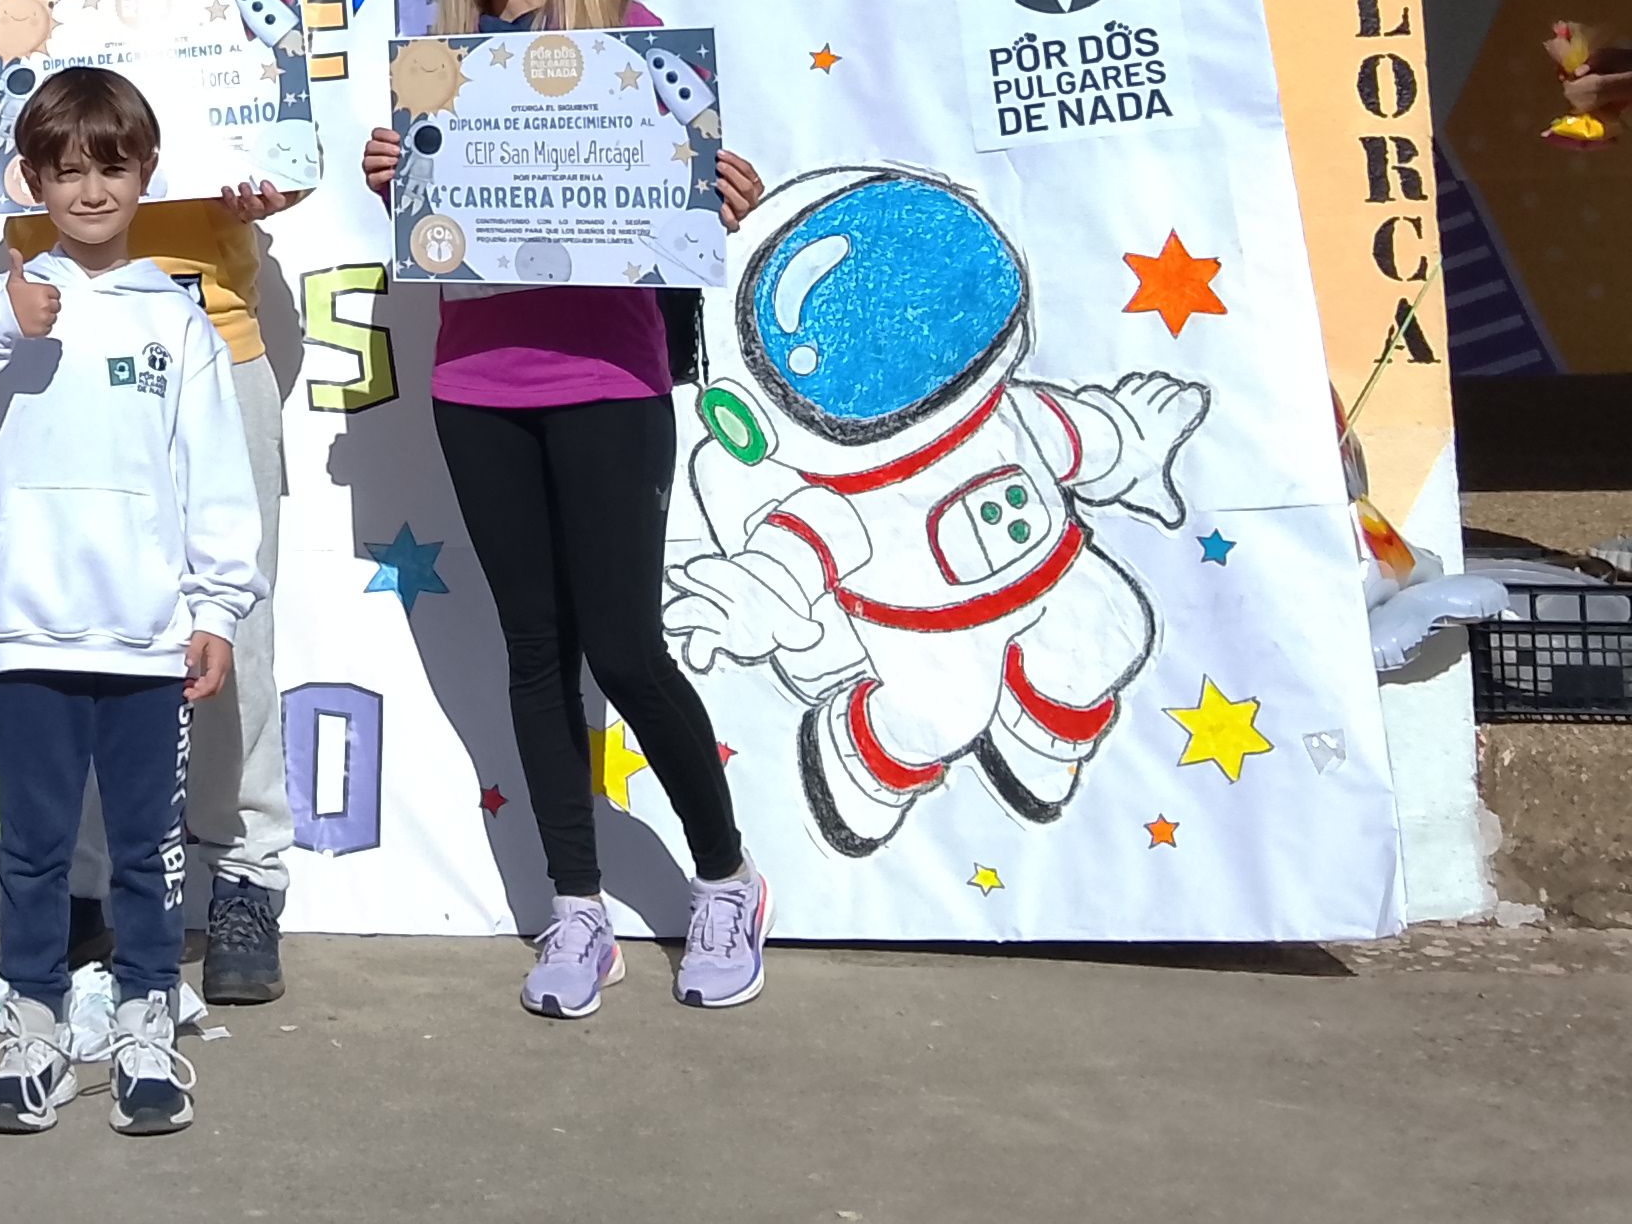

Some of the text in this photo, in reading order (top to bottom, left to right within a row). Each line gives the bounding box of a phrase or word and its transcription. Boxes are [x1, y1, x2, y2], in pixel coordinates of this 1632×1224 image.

[97, 54, 113, 65] DE
[229, 44, 242, 53] AL
[989, 28, 1159, 76] POR DOS
[531, 67, 578, 78] DE NADA
[993, 60, 1166, 104] PULGARES
[209, 97, 276, 126] DARÍO
[449, 116, 655, 131] DIPLOMA DE AGRADECIMIENTO AL
[997, 89, 1174, 136] DE NADA
[465, 139, 644, 171] CEIP San Miguel Arcágel
[561, 186, 607, 208] POR
[615, 178, 686, 209] DARÍO
